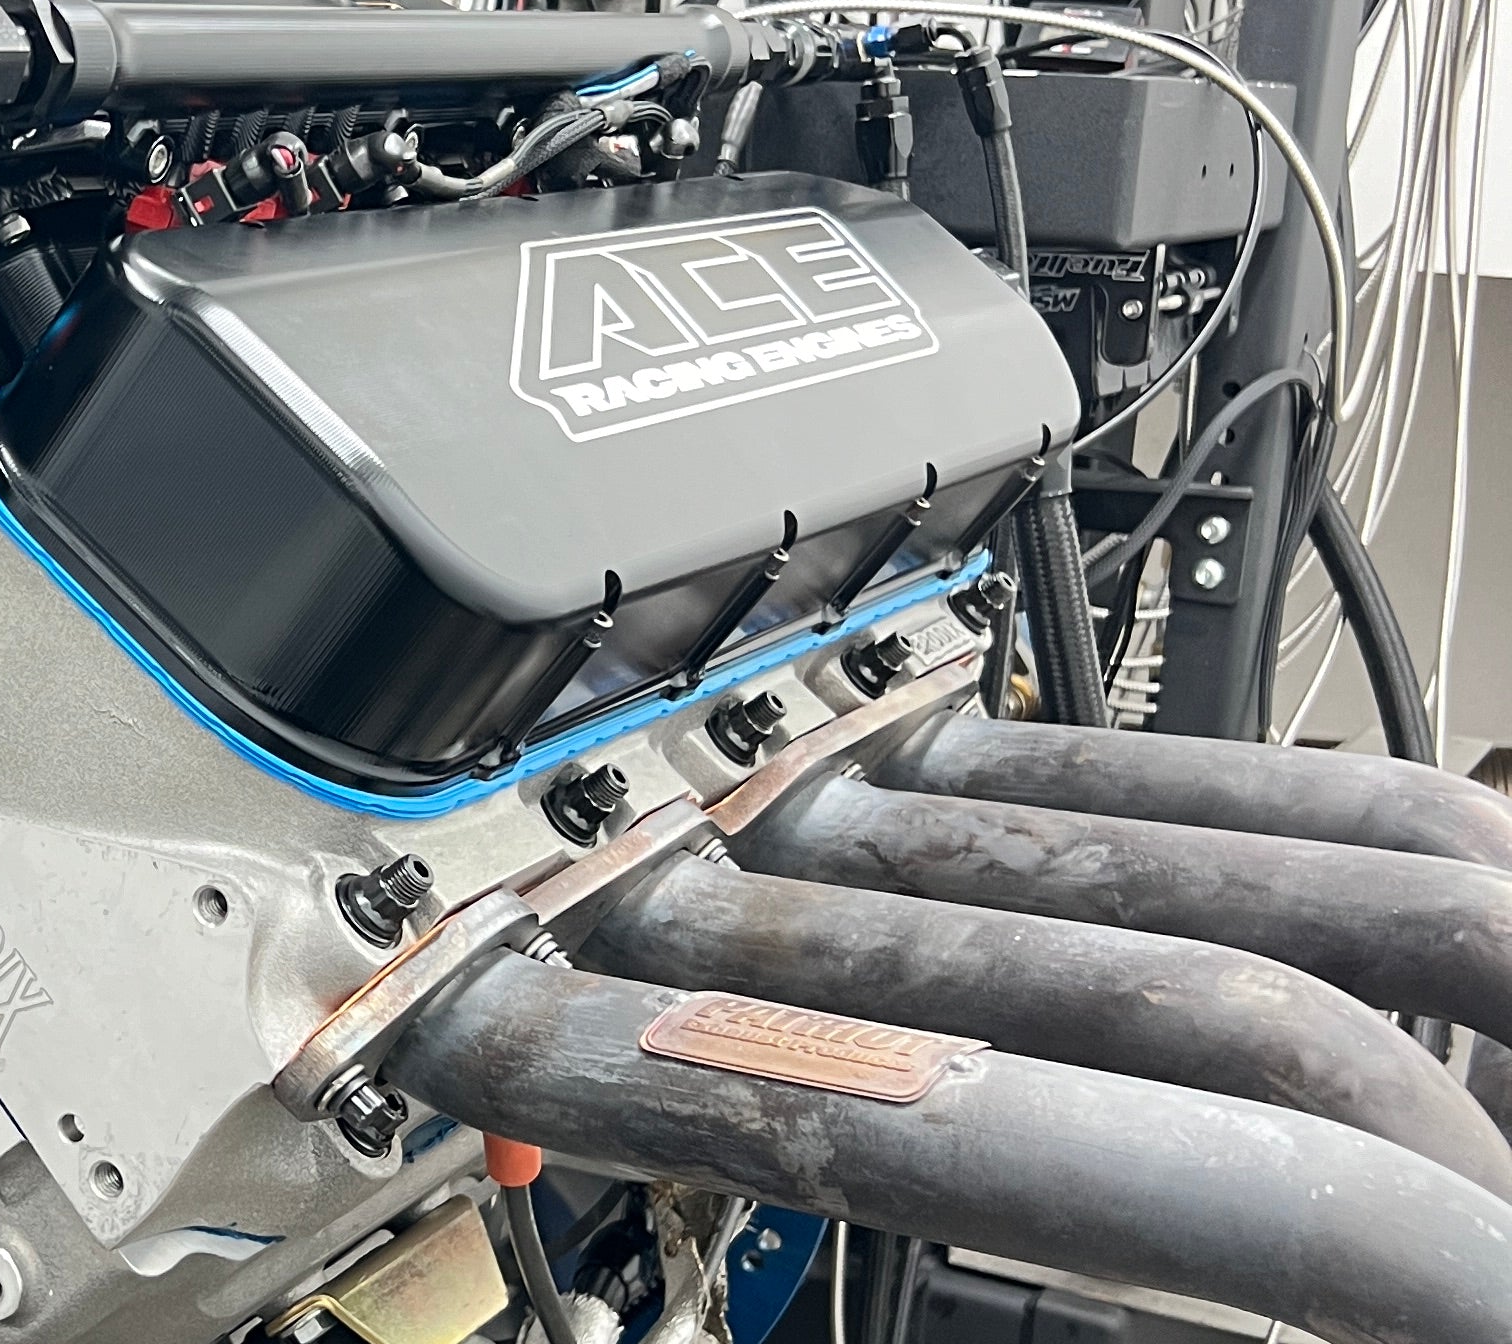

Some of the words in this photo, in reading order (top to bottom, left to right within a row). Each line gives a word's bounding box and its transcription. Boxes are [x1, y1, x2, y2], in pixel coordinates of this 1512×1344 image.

[538, 216, 902, 381] ACE
[549, 350, 758, 417] RACING
[741, 313, 923, 374] ENGINES
